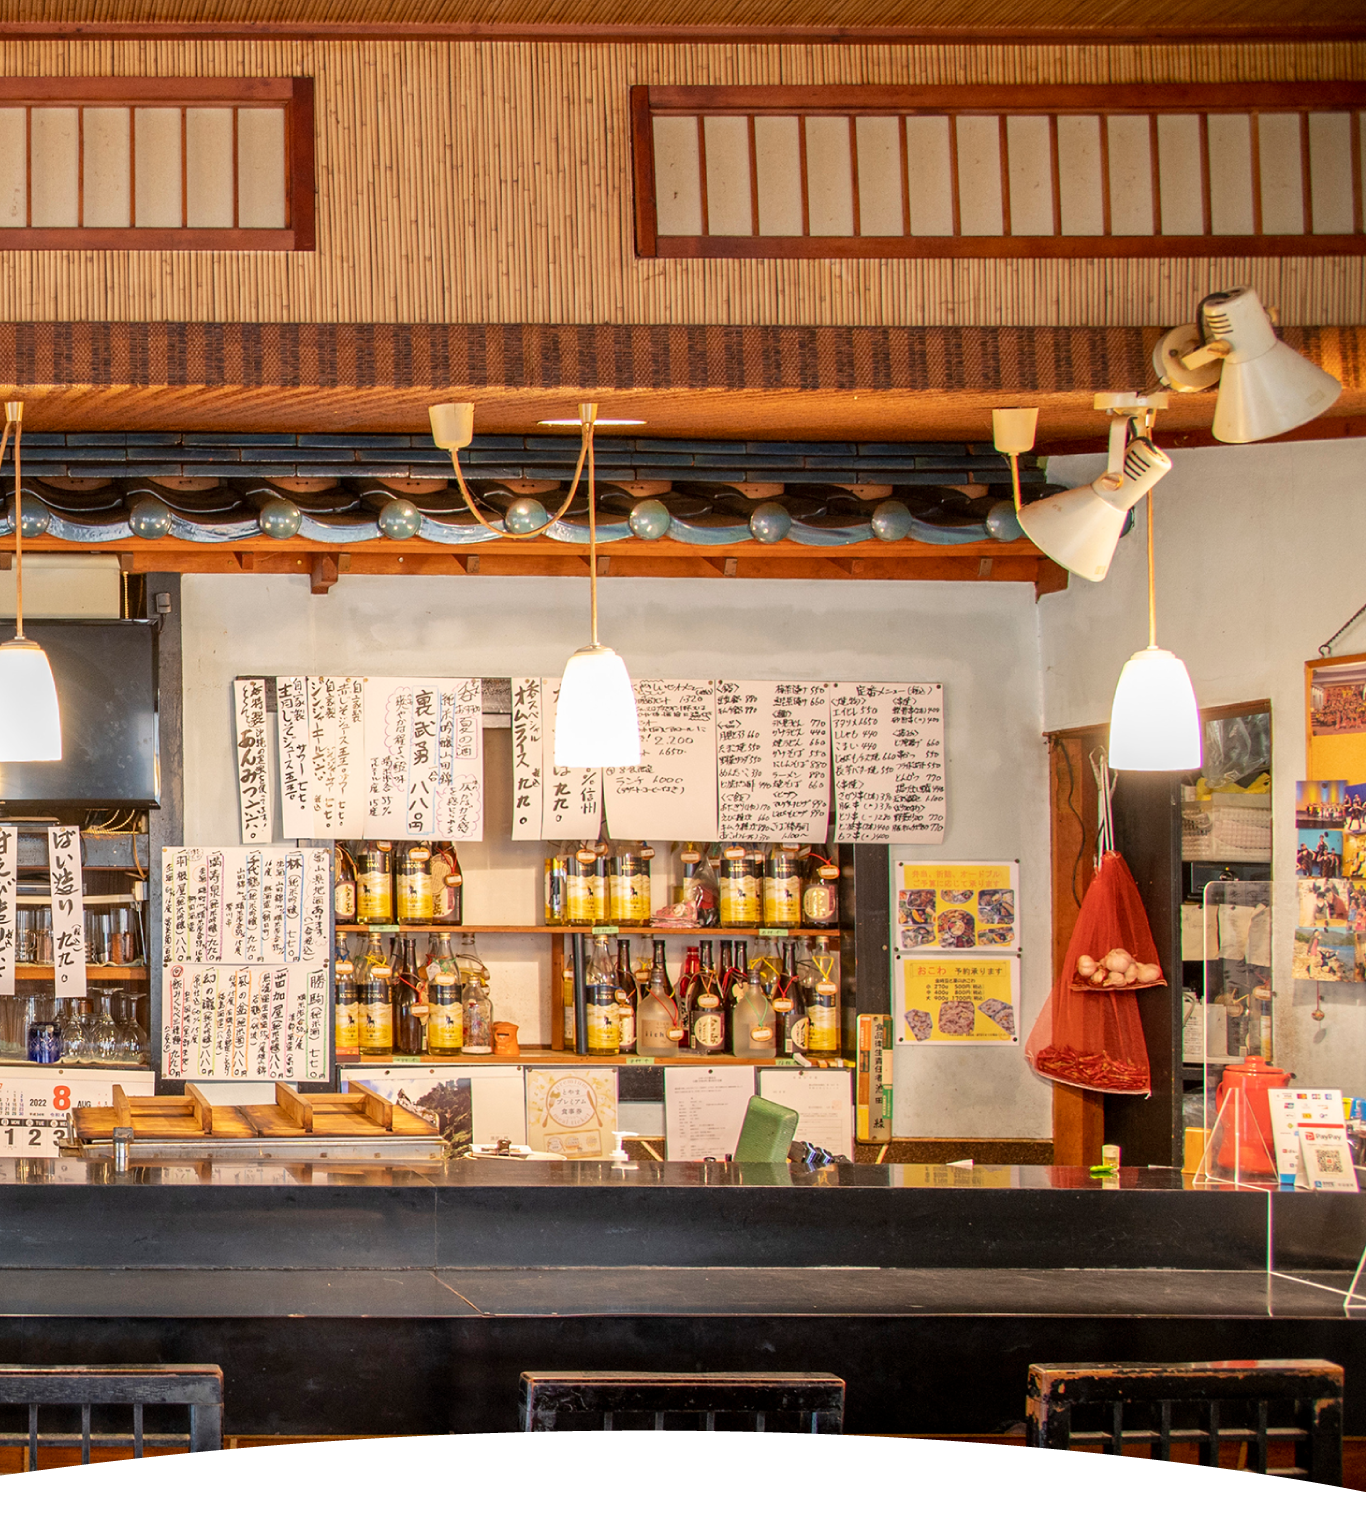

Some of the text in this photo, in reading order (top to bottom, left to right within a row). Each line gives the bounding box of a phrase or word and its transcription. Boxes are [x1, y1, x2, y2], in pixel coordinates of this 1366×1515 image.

[810, 686, 825, 695] 550
[293, 678, 305, 721] 自家製
[325, 679, 336, 719] 自家製
[351, 681, 362, 722] 自家製
[810, 698, 825, 706] 660
[860, 706, 877, 714] 550
[413, 689, 436, 766] 裏武勇
[514, 686, 529, 768] オムライス
[458, 717, 474, 756] 夏の酒
[747, 730, 760, 738] 660
[862, 730, 878, 738] 440
[748, 743, 760, 751] 550
[861, 742, 877, 750] 440
[809, 750, 826, 758] 550
[882, 752, 896, 760] 660
[238, 729, 257, 797] あんみつ
[296, 744, 306, 776] サワー
[750, 755, 761, 763] 550
[881, 766, 894, 774] 550
[808, 781, 824, 789] 660
[286, 859, 303, 870] 林
[52, 831, 79, 916] ばい造り
[918, 966, 946, 975] おこわ
[53, 1085, 71, 1110] 8
[4, 1128, 14, 1145] 1
[28, 1129, 41, 1145] 2
[53, 1130, 65, 1146] 3
